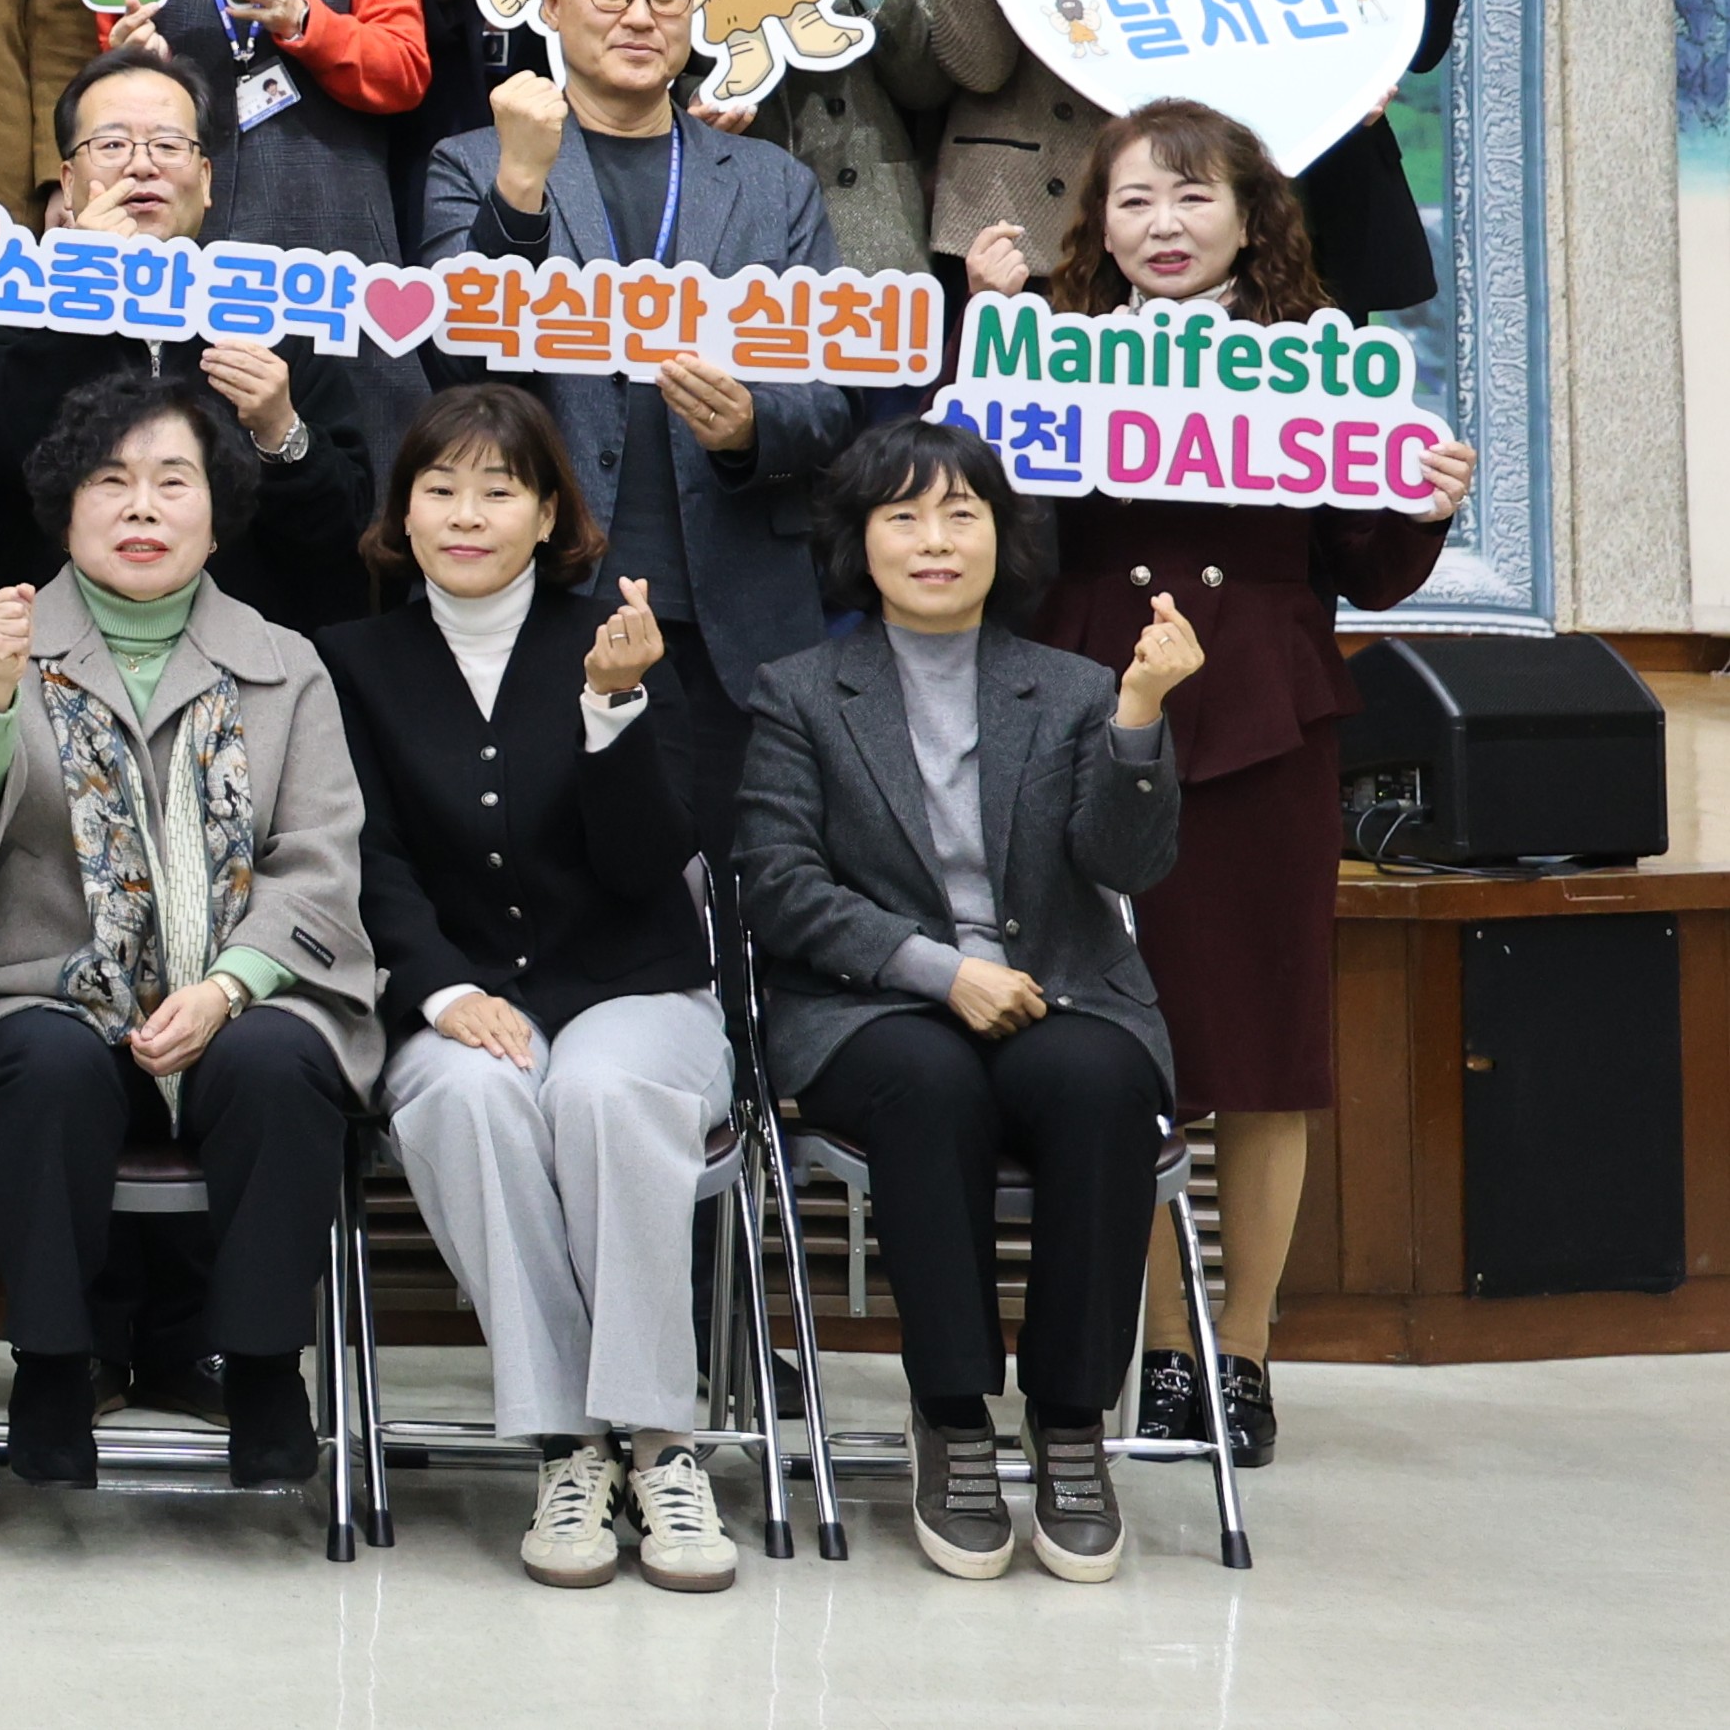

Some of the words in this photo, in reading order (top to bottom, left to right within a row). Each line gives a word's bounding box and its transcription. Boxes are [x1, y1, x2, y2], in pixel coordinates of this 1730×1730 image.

[207, 255, 356, 342] 공약
[444, 266, 708, 364] 확실한
[729, 279, 930, 375] 실천!
[972, 304, 1401, 398] Manifesto
[1107, 410, 1440, 500] DALSEO
